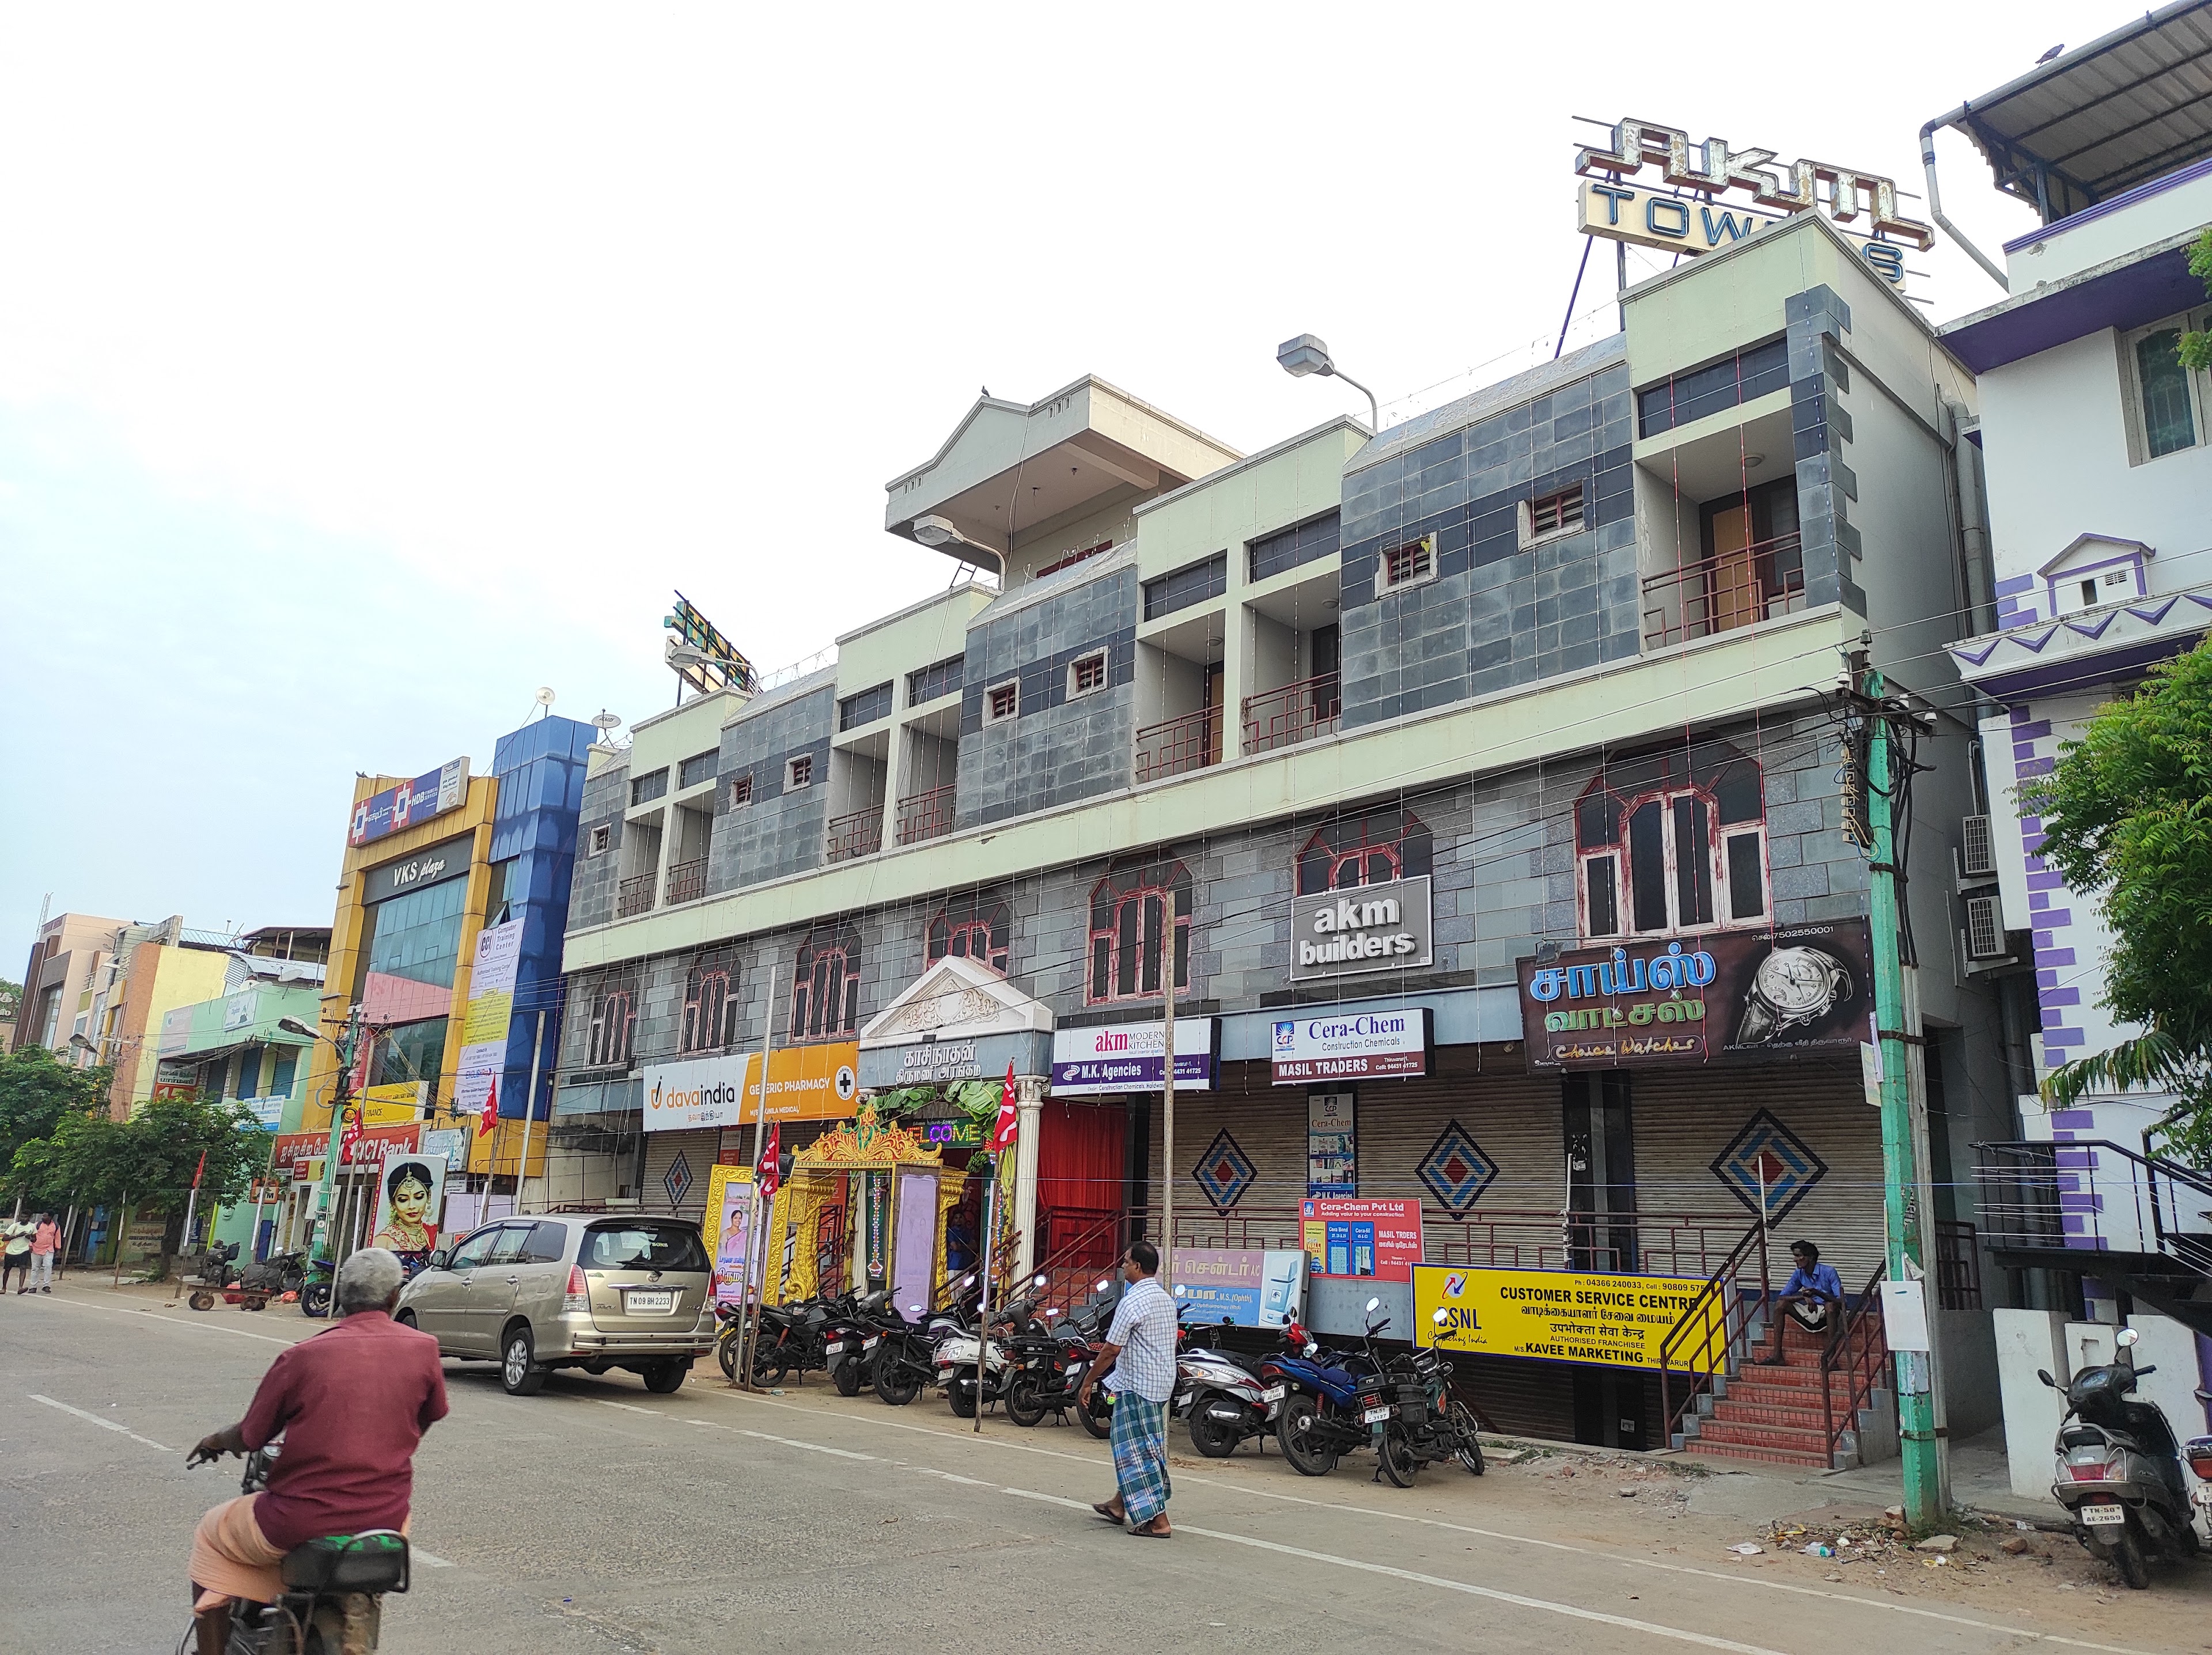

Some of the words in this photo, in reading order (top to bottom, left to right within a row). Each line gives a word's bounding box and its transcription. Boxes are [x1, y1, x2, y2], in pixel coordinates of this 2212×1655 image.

[1592, 183, 1904, 283] TOWS
[411, 791, 425, 806] HDB
[394, 861, 418, 886] VKS
[418, 858, 446, 881] plaza
[1314, 898, 1400, 933] akm
[497, 933, 515, 942] Training
[498, 924, 517, 934] Computer
[1773, 926, 1834, 939] 7502550001
[496, 941, 514, 950] Center
[1300, 932, 1416, 965] builders
[1530, 941, 1717, 1002] சாய்ஸ்
[1544, 991, 1706, 1032] வாட்சஸ்
[1309, 1016, 1406, 1039] Cera-Chem
[1096, 1031, 1127, 1052] akm
[1129, 1031, 1165, 1040] MODERN
[1128, 1040, 1164, 1050] KITCHEN
[1322, 1040, 1362, 1051] Construction
[1365, 1037, 1400, 1048] Chemicals
[1556, 1043, 1616, 1059] Choice
[1621, 1036, 1695, 1055] Watches
[903, 1039, 976, 1069] காசிநாதன்
[895, 1068, 933, 1084] திருமண
[1082, 1065, 1100, 1078] M.K.
[1102, 1062, 1142, 1081] Agencies
[1279, 1062, 1312, 1077] MASIL
[1316, 1059, 1368, 1074] TRADERS
[666, 1081, 735, 1108] davaindia
[749, 1082, 783, 1095] GEERIC
[785, 1077, 831, 1092] PHARMACY
[366, 1108, 383, 1117] FINANCE
[1312, 1118, 1351, 1128] Cera-Chem
[377, 1137, 412, 1160] Bank
[1320, 1202, 1369, 1211] Cera-Chem
[1372, 1203, 1387, 1211] Pvt
[1389, 1202, 1404, 1211] Ltd
[1396, 1230, 1417, 1239] TRDERS
[1251, 1264, 1260, 1277] A/C
[1586, 1279, 1610, 1287] 04366
[1501, 1286, 1572, 1302] CUSTOMER
[1576, 1291, 1635, 1307] SERVICE
[1639, 1294, 1698, 1311] CENTRE
[1521, 1303, 1598, 1319] வாடிக்கையாளர்
[1601, 1308, 1634, 1321] சேவை
[1637, 1312, 1675, 1324] மையம்
[1468, 1334, 1487, 1344] India
[1550, 1321, 1595, 1335] उपभोक्ता
[1599, 1323, 1619, 1337] सेवा
[1622, 1325, 1645, 1340] केन्द्र
[1550, 1335, 1596, 1345] AUTHORISED
[1598, 1340, 1646, 1349] FRANCHISEE
[1526, 1342, 1565, 1355] KAVEE
[1569, 1346, 1643, 1363] MARKETING
[1647, 1357, 1688, 1367] THIRVARUR
